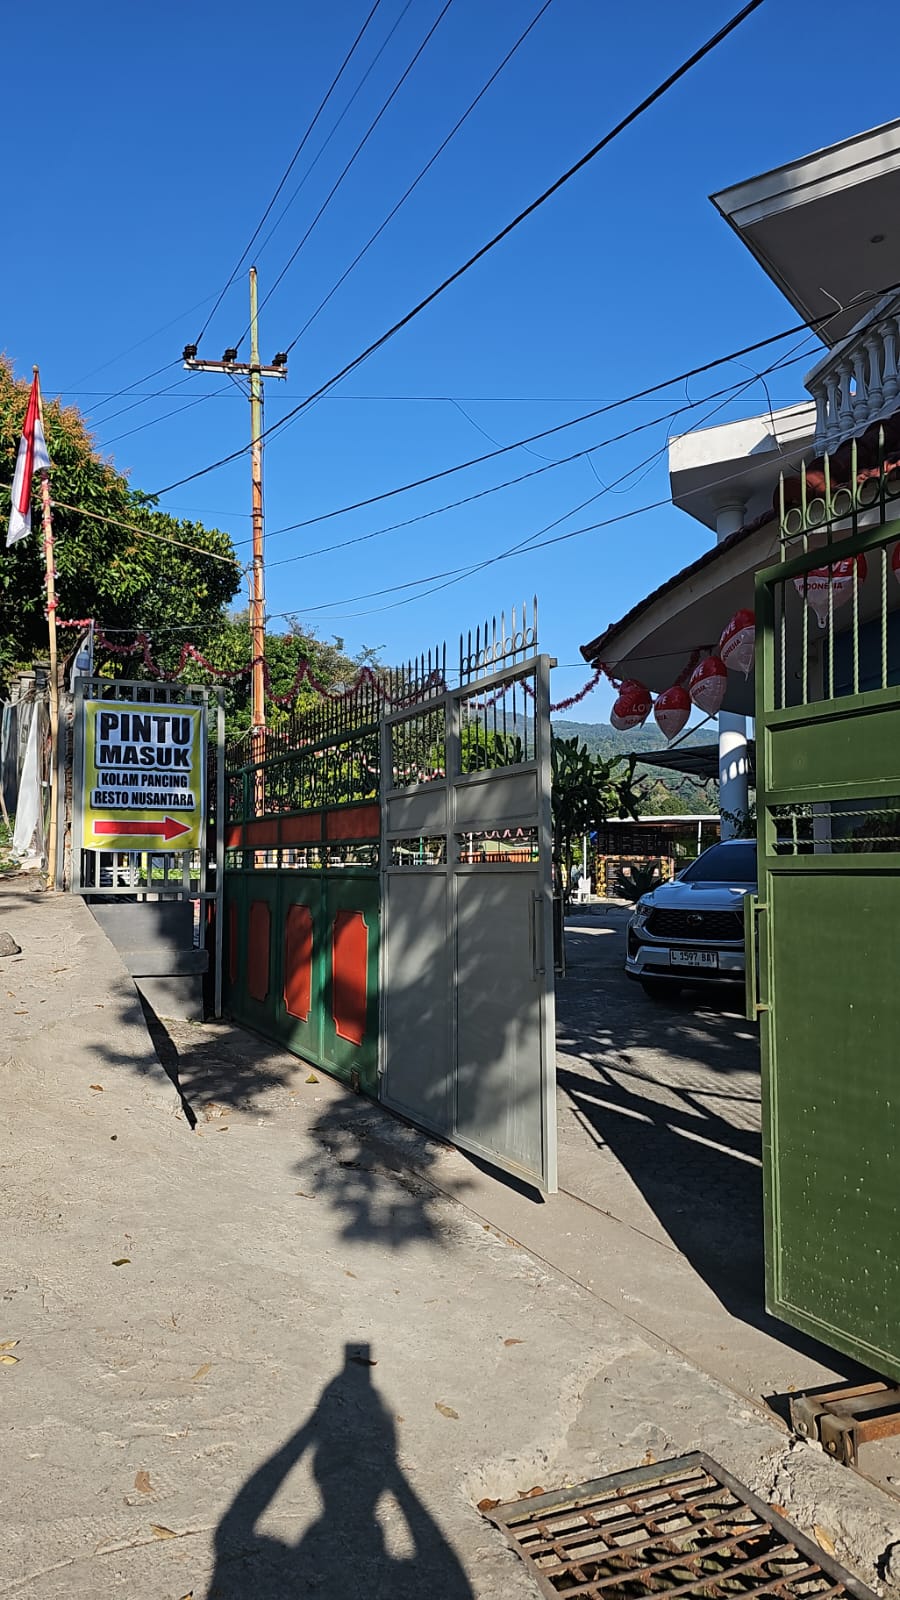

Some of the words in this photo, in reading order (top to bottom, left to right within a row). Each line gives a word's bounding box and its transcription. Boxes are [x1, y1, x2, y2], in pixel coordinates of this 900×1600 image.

[798, 582, 843, 591] INDONEIA
[100, 712, 191, 745] PINTU
[99, 744, 190, 767] MASUK
[101, 772, 139, 787] KOLAM
[141, 774, 188, 788] PANCING
[94, 790, 129, 805] RESTO
[131, 791, 194, 806] NUSANTARA
